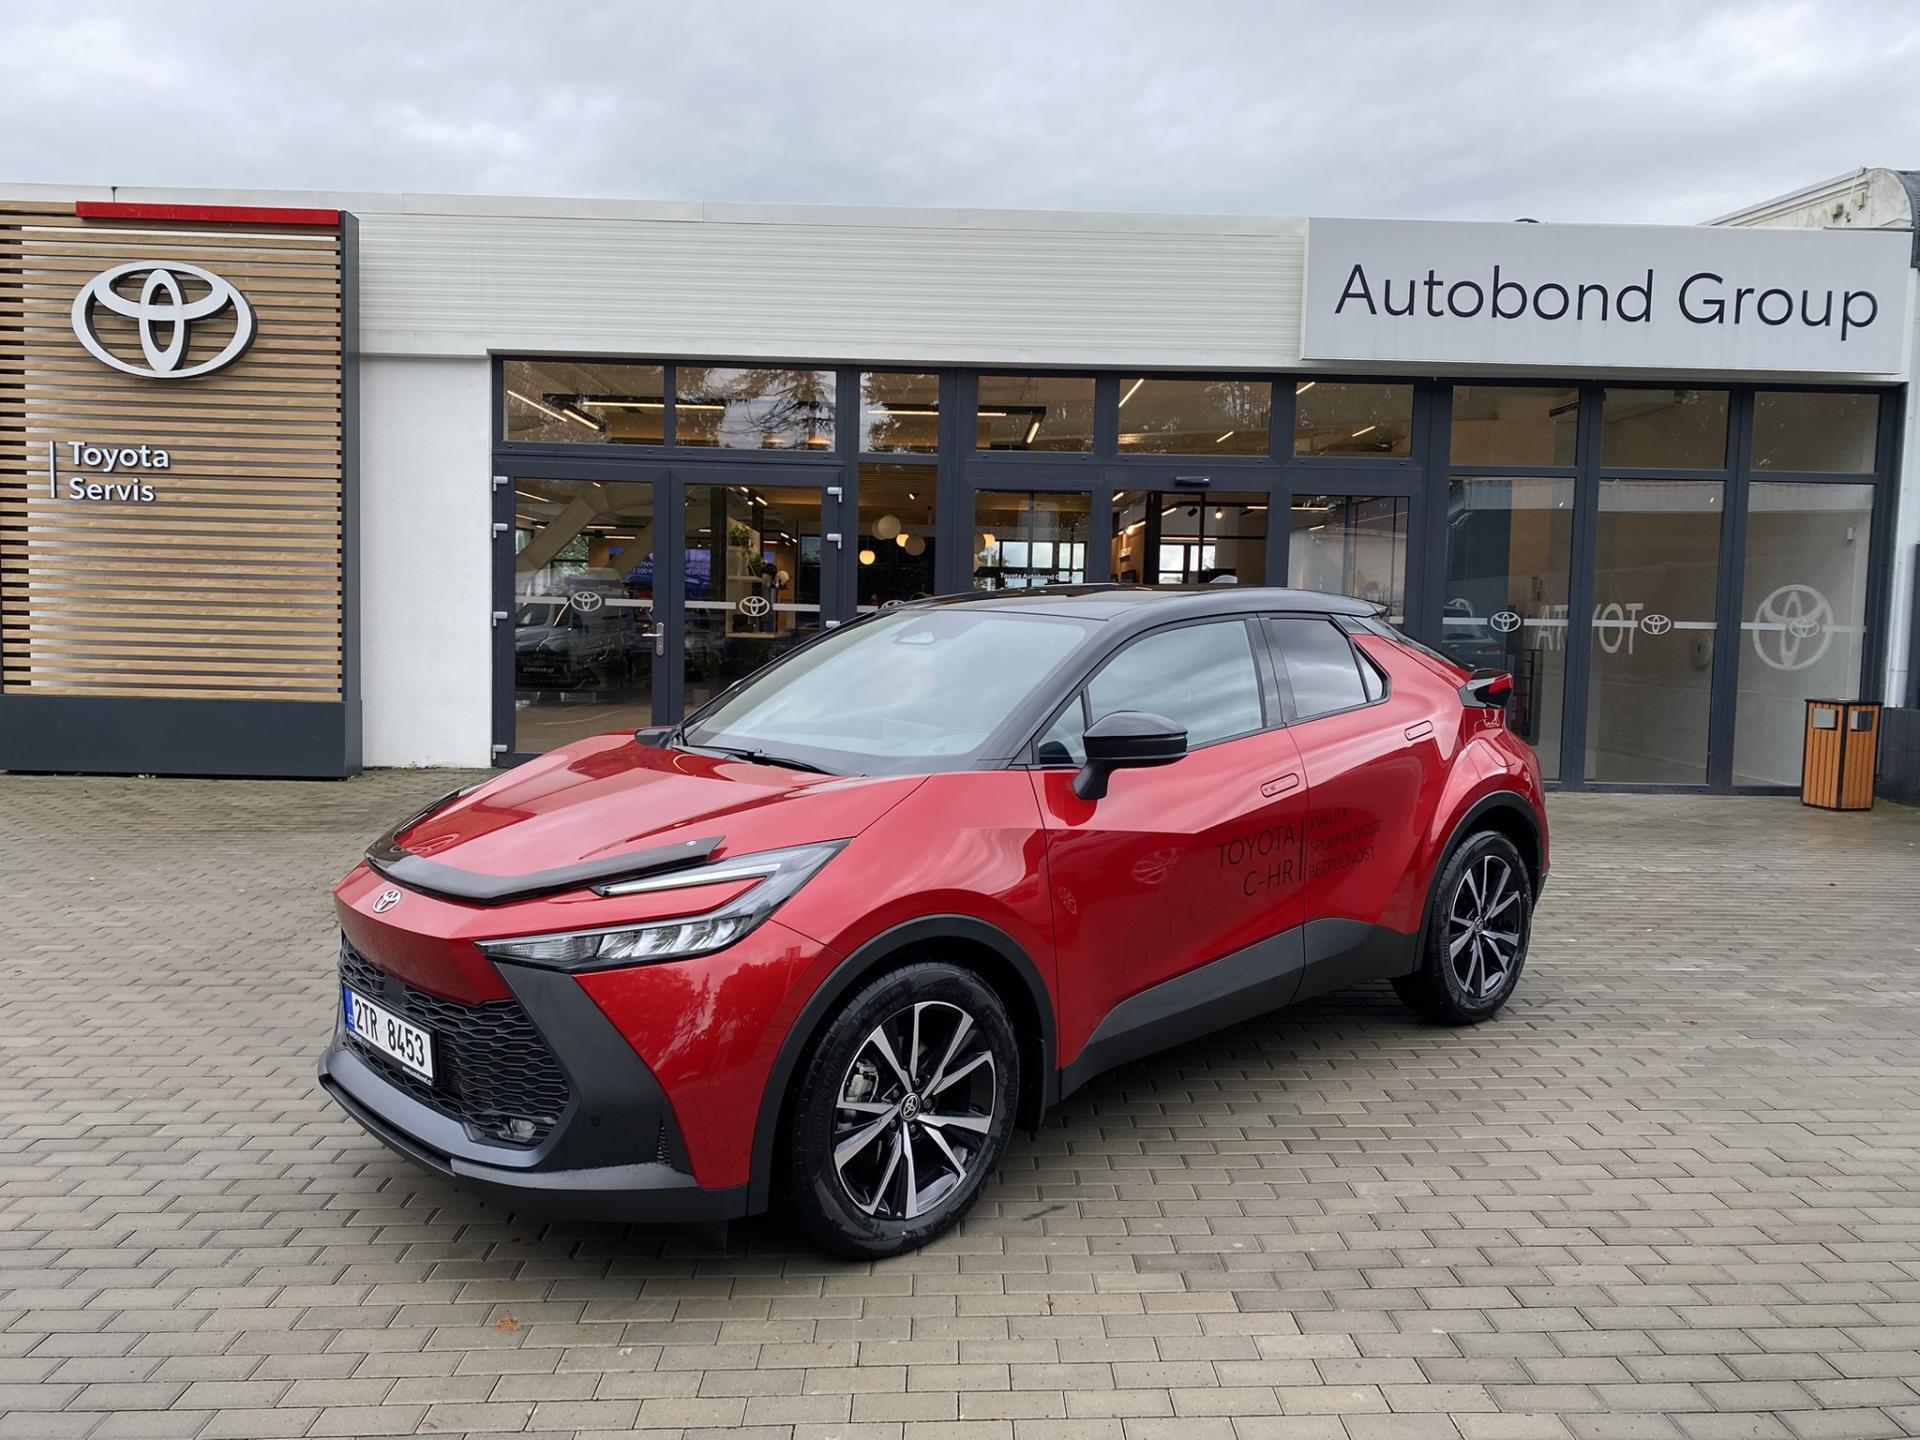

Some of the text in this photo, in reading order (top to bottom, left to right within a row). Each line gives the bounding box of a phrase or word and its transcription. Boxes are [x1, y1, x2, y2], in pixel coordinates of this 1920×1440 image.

[1334, 263, 1879, 341] Autobond Group
[67, 440, 170, 473] Toyota
[68, 477, 156, 502] Servis
[1216, 823, 1296, 869] TOYOTA
[1243, 859, 1294, 896] C-HR
[354, 998, 378, 1041] 2TR
[387, 1018, 425, 1068] 8453
